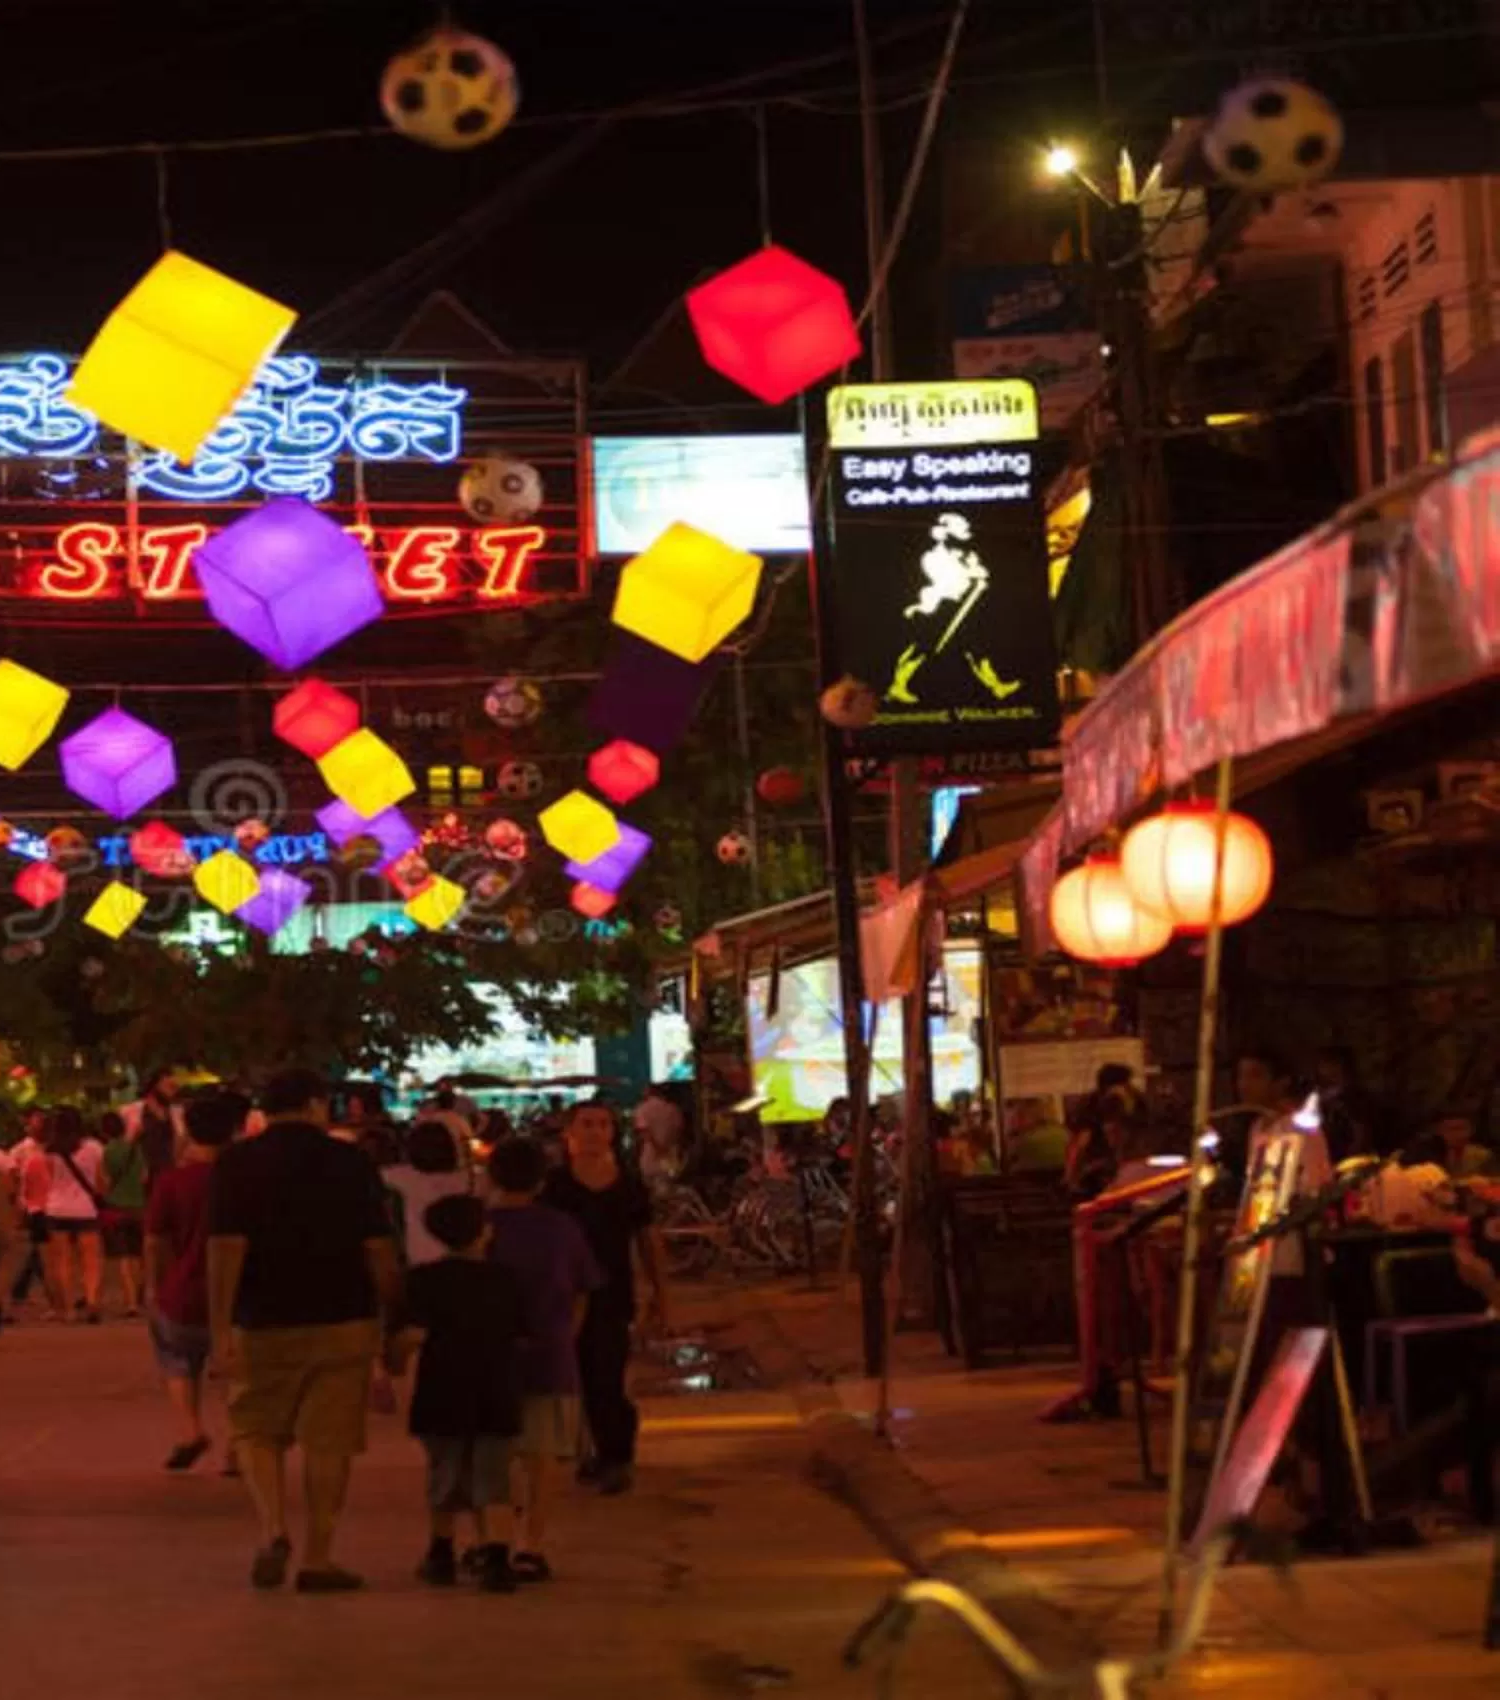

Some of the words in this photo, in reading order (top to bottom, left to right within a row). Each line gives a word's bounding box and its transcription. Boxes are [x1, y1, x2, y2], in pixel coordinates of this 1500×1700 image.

[842, 455, 908, 482] Easy
[912, 450, 1031, 480] Speaking
[41, 522, 545, 598] STET
